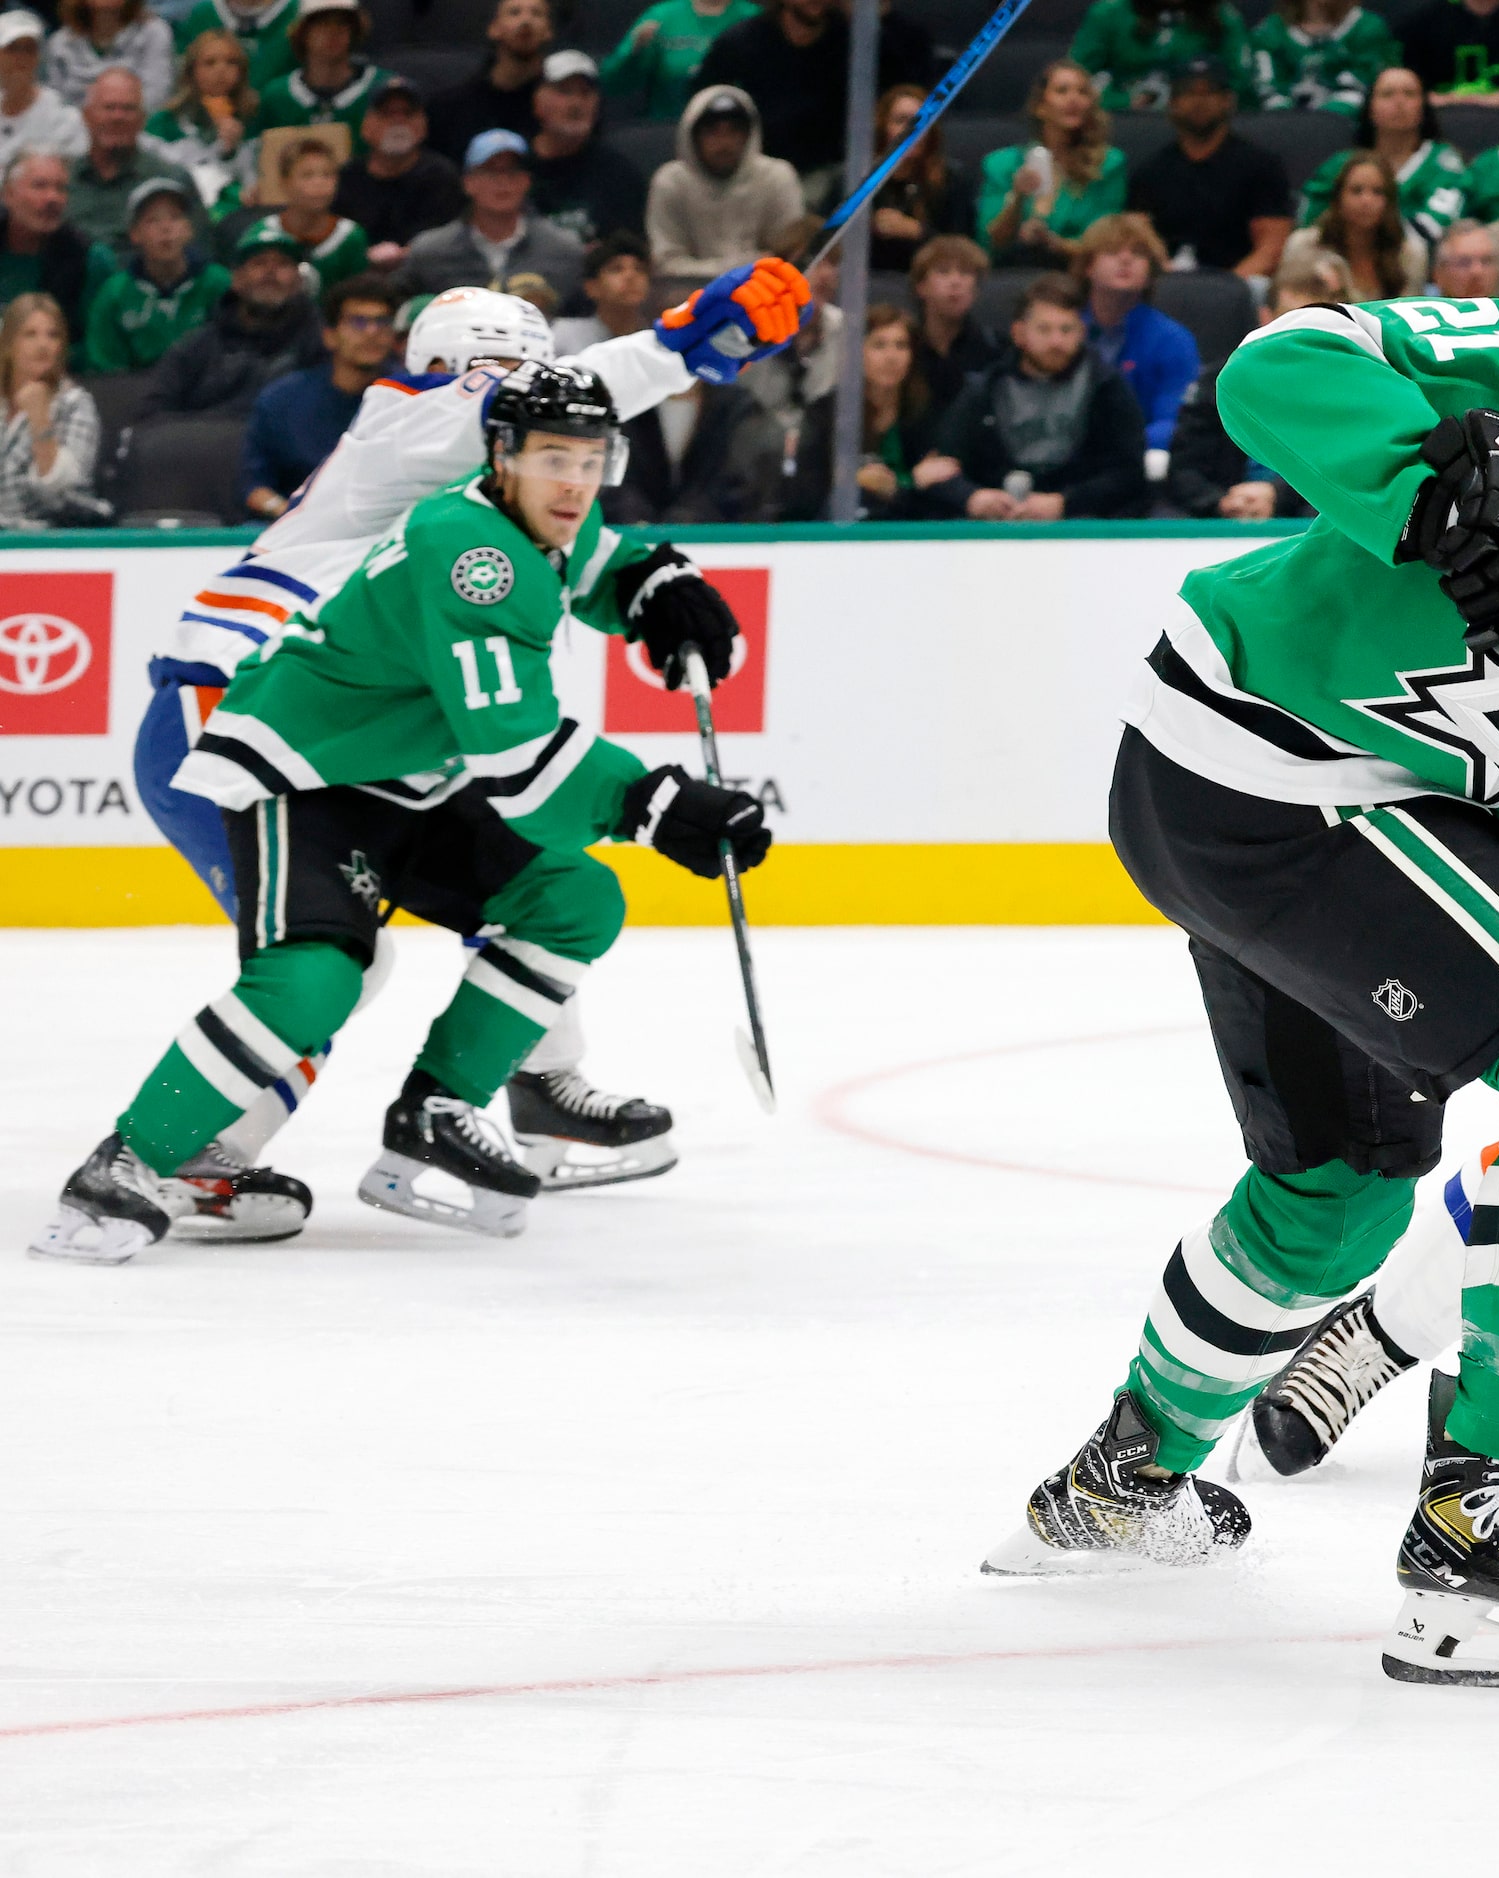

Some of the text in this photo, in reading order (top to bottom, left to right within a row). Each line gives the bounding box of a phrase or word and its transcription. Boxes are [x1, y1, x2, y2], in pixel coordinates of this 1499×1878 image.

[452, 636, 522, 710] 11
[1391, 988, 1401, 1015] NHL
[1117, 1444, 1148, 1458] CCM
[1402, 1523, 1468, 1588] CCM
